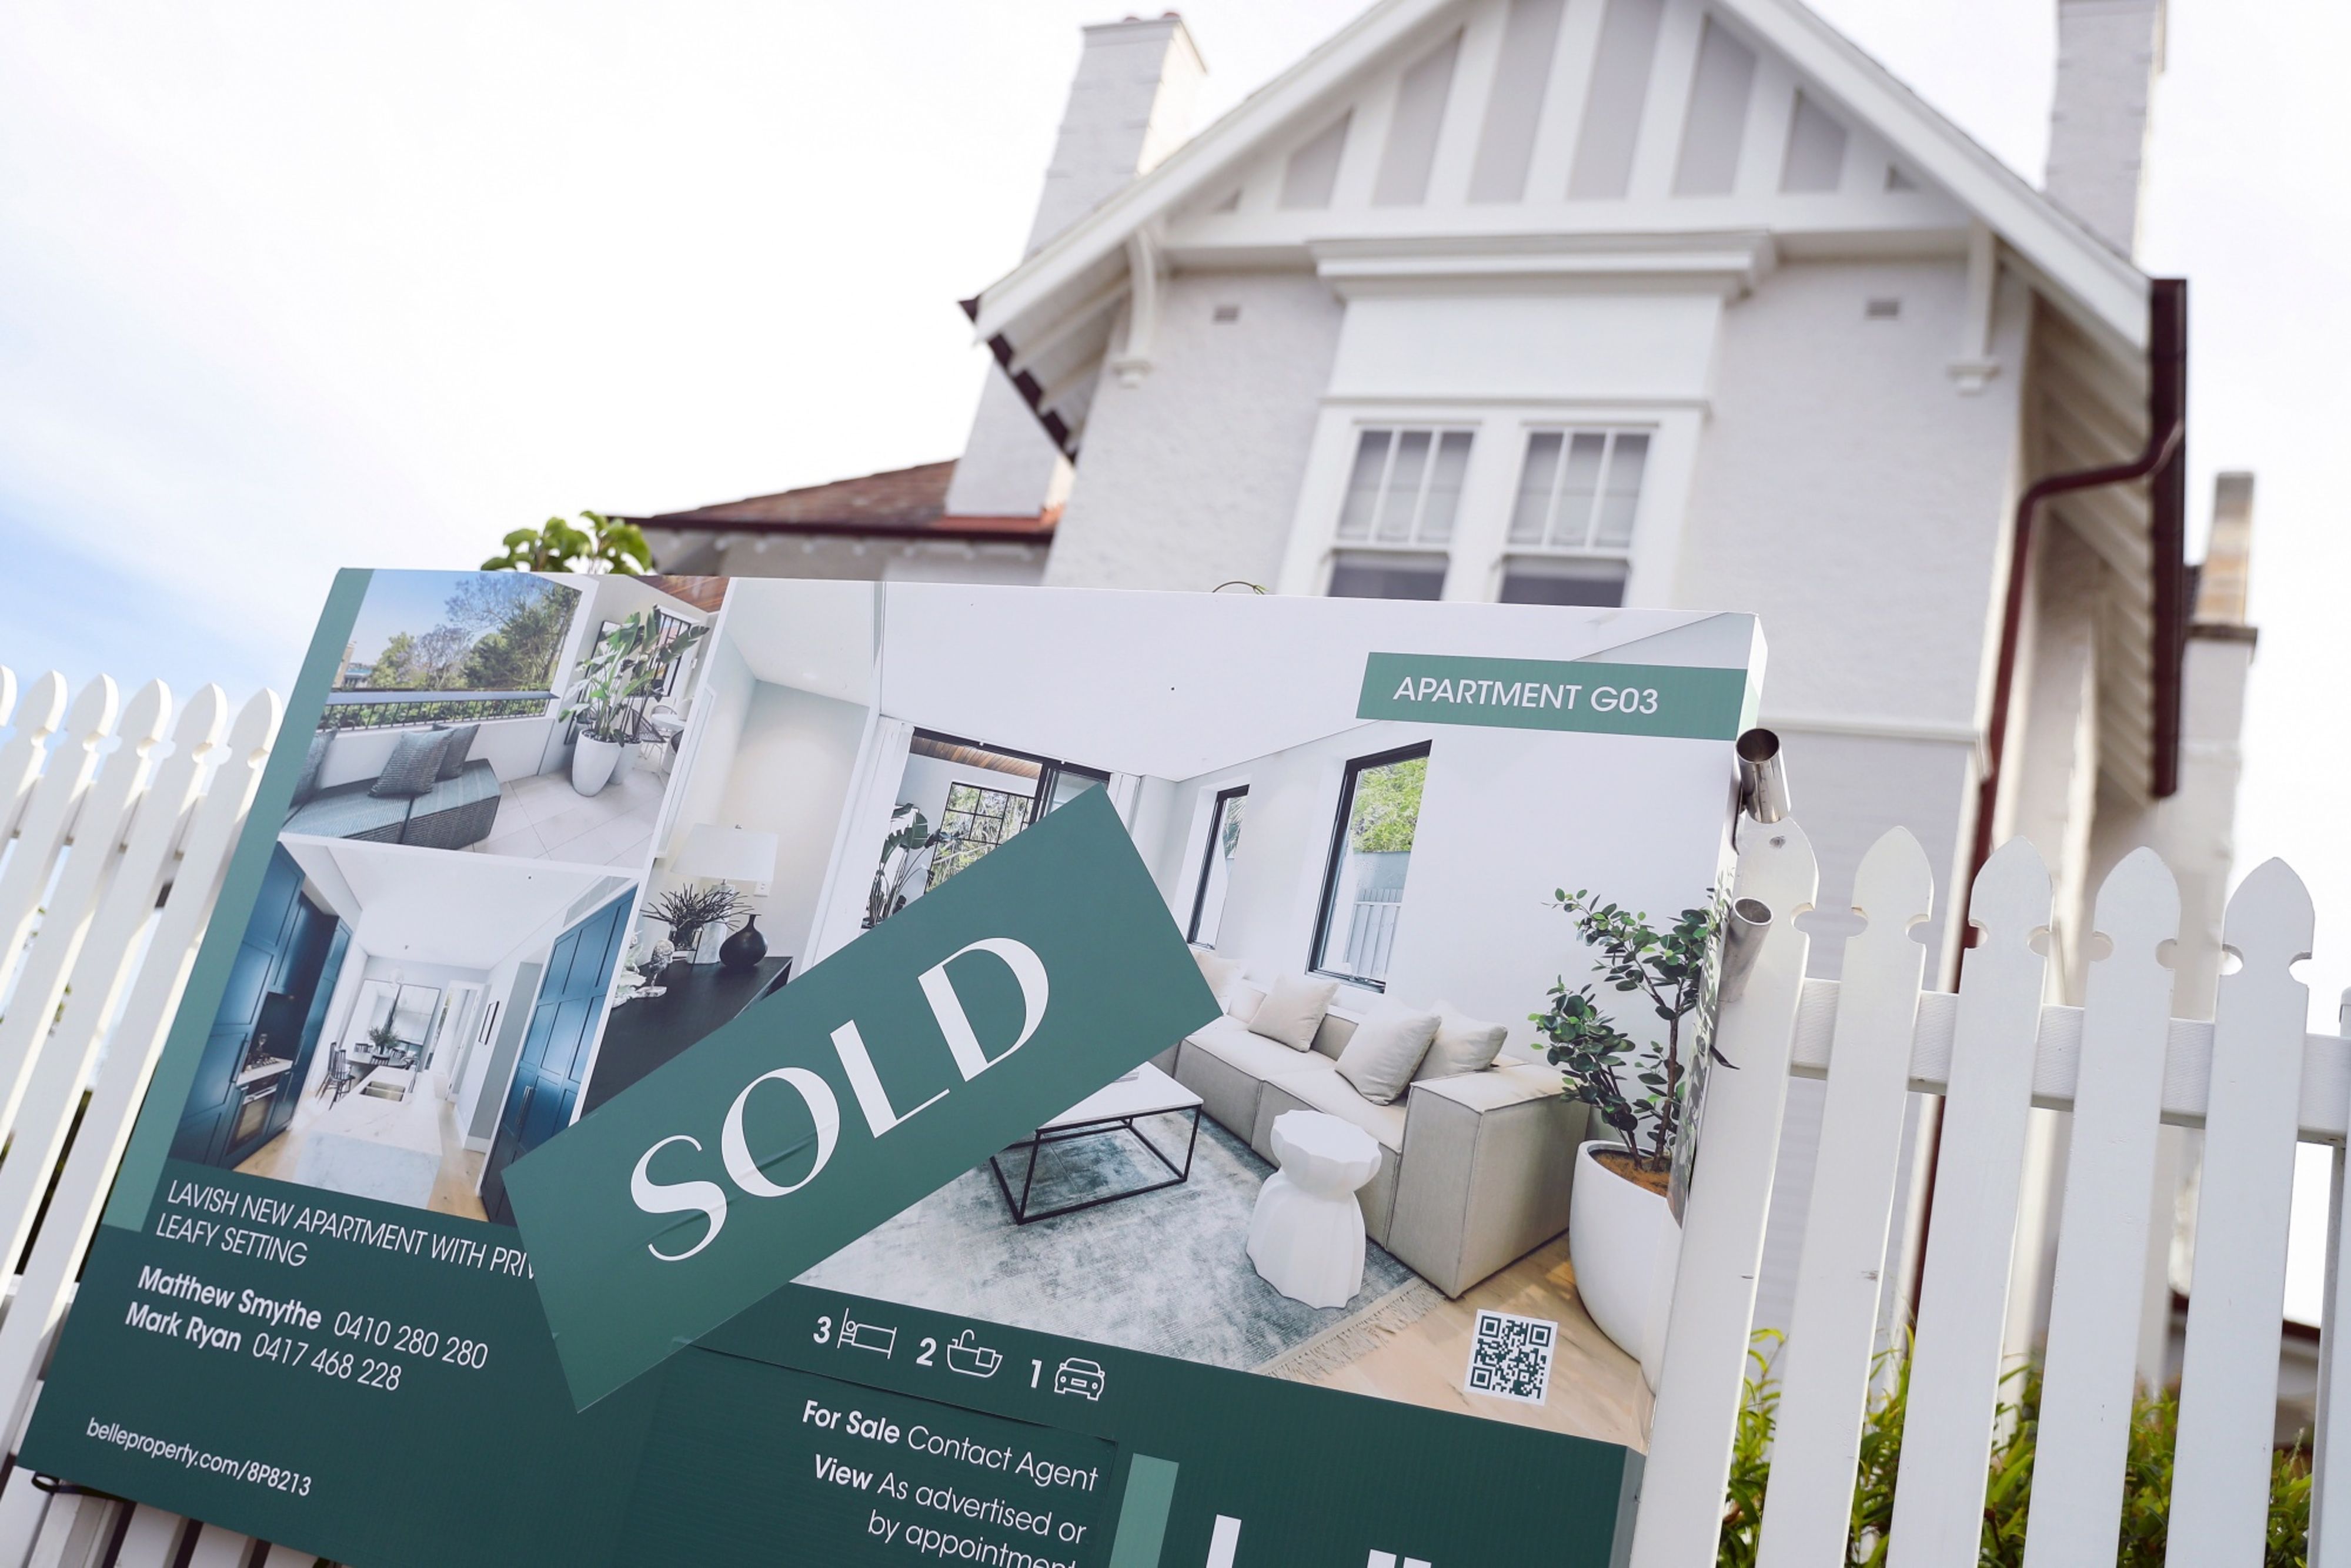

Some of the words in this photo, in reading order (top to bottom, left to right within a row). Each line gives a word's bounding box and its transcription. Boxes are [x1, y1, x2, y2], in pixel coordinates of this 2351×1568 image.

[1392, 676, 1583, 710] APARTMENT
[1590, 686, 1658, 714] G03
[630, 937, 1049, 1261] SOLD
[156, 1213, 220, 1248] LEAFY
[221, 1227, 308, 1266] SETTING
[168, 1180, 239, 1215] LAVISH
[241, 1195, 295, 1226] NEW
[293, 1207, 428, 1255] APARTMENT
[432, 1233, 487, 1268] WITH
[125, 1302, 182, 1336] Mark
[185, 1316, 241, 1352] Ryan
[253, 1333, 309, 1366] 0417
[310, 1348, 354, 1379] 468
[357, 1359, 402, 1390] 228
[138, 1265, 235, 1309] Matthew
[238, 1289, 322, 1330] Smythe
[334, 1311, 391, 1346] 0410
[393, 1325, 439, 1357] 280
[442, 1336, 488, 1369] 280
[813, 1316, 831, 1343] 3
[916, 1337, 937, 1366] 2
[1031, 1359, 1042, 1389] 1
[86, 1417, 311, 1496] belleproperty.com/8P8213
[802, 1400, 841, 1429] For
[846, 1410, 900, 1444] Sale
[908, 1426, 1013, 1470] Contact
[1015, 1452, 1098, 1491] Agent
[816, 1454, 873, 1490] View
[877, 1472, 908, 1500] As
[916, 1486, 1052, 1536] advertised
[1058, 1522, 1087, 1544] or
[868, 1509, 900, 1543] by
[906, 1525, 1077, 1568] appointme
